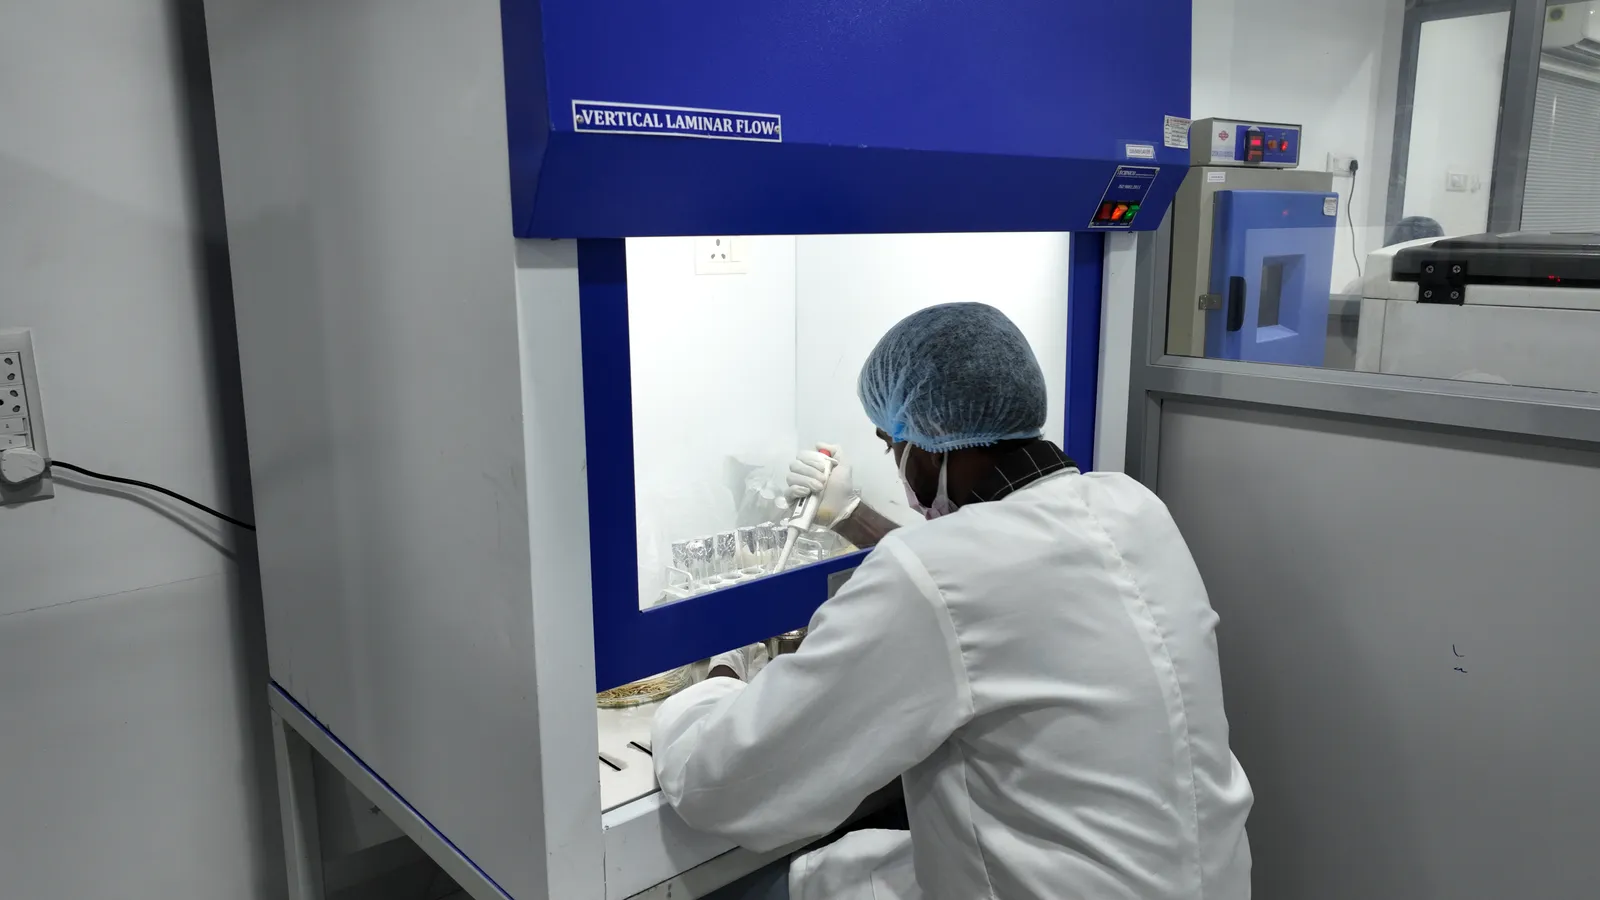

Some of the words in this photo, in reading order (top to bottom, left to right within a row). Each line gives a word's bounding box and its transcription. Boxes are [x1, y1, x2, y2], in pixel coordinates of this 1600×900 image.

[581, 109, 663, 128] VERTICAL
[665, 114, 734, 133] LAMINAR
[735, 119, 776, 135] FLOW
